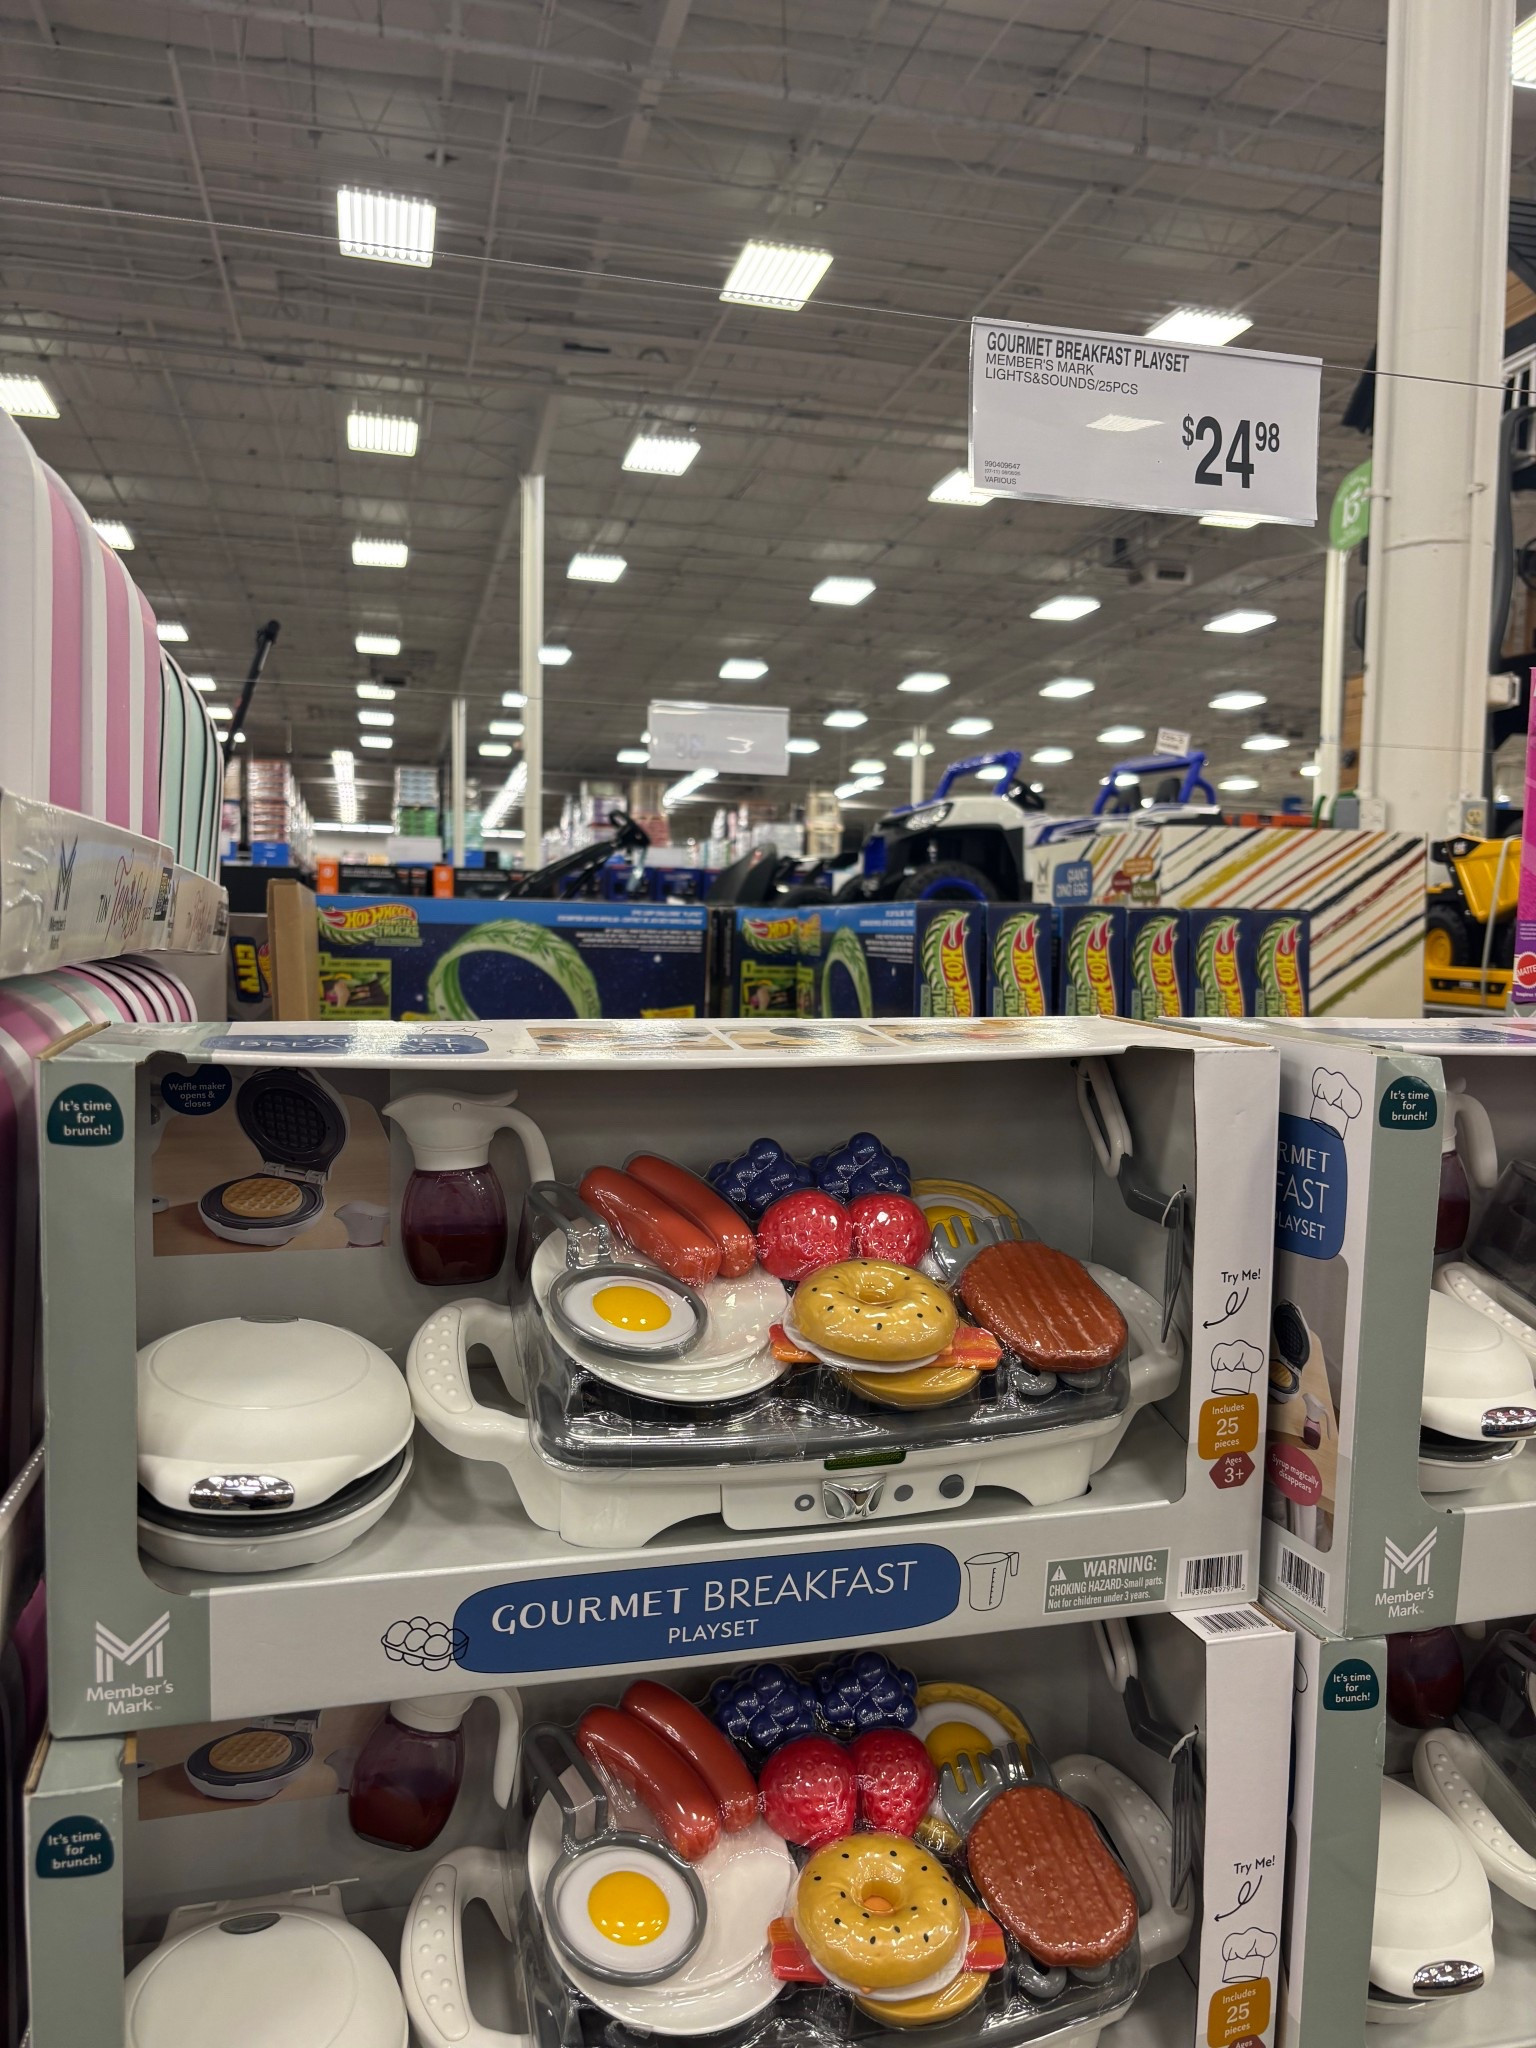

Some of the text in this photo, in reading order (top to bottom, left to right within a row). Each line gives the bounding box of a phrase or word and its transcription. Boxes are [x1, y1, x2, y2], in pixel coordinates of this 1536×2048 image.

[987, 331, 1190, 373] GOURMET BREAKFAST PLAYSET
[985, 352, 1095, 376] MEMBER'S MARK
[985, 366, 1139, 395] LIGHTS&SOUNDS/25PCS
[984, 475, 1017, 485] VARIOUS
[343, 910, 372, 929] HOT
[234, 944, 260, 993] CITY
[942, 945, 965, 979] HOT
[1012, 950, 1037, 981] HOT
[1086, 950, 1111, 982] HOT
[1151, 953, 1177, 985] HOT
[1214, 952, 1239, 985] HOT
[1275, 952, 1300, 984] HOT
[1516, 964, 1536, 977] MATTE
[168, 1082, 226, 1091] Waffle maker
[180, 1090, 216, 1101] opens &
[1390, 1090, 1430, 1100] It's time
[59, 1100, 112, 1112] It's time
[184, 1100, 212, 1108] closes
[1402, 1100, 1416, 1111] for
[76, 1112, 96, 1125] for
[1391, 1111, 1428, 1121] brunch!
[62, 1123, 112, 1137] brunch!
[1221, 1269, 1261, 1285] Try Me!
[1212, 1403, 1245, 1415] Includes
[1216, 1417, 1239, 1436] 25
[1214, 1437, 1240, 1451] pieces
[1225, 1456, 1242, 1466] Ages
[1224, 1467, 1244, 1483] 3+
[1272, 1453, 1319, 1488] Syrup magically
[1278, 1469, 1312, 1493] disappears
[1083, 1554, 1157, 1578] WARNING:
[1049, 1576, 1164, 1597] CHOKING HAZARD-Small parts.
[491, 1560, 918, 1634] GOURMET BREAKFAST
[1047, 1591, 1150, 1609] Not for children under 3 years.
[1374, 1587, 1434, 1606] Member's
[1387, 1604, 1419, 1619] Mark
[668, 1618, 760, 1644] PLAYSET
[1333, 1672, 1371, 1683] It's time
[86, 1679, 174, 1702] Member's
[1345, 1683, 1359, 1693] for
[1335, 1692, 1371, 1703] brunch!
[107, 1698, 154, 1716] Mark
[48, 1831, 102, 1846] It's time
[66, 1844, 85, 1856] for
[52, 1853, 102, 1870] brunch!
[1234, 1855, 1275, 1876] Try Me!
[1222, 1988, 1257, 2004] Includes
[1226, 2002, 1250, 2024] 25
[1224, 2023, 1251, 2038] pieces
[1235, 2039, 1253, 2048] Ages
